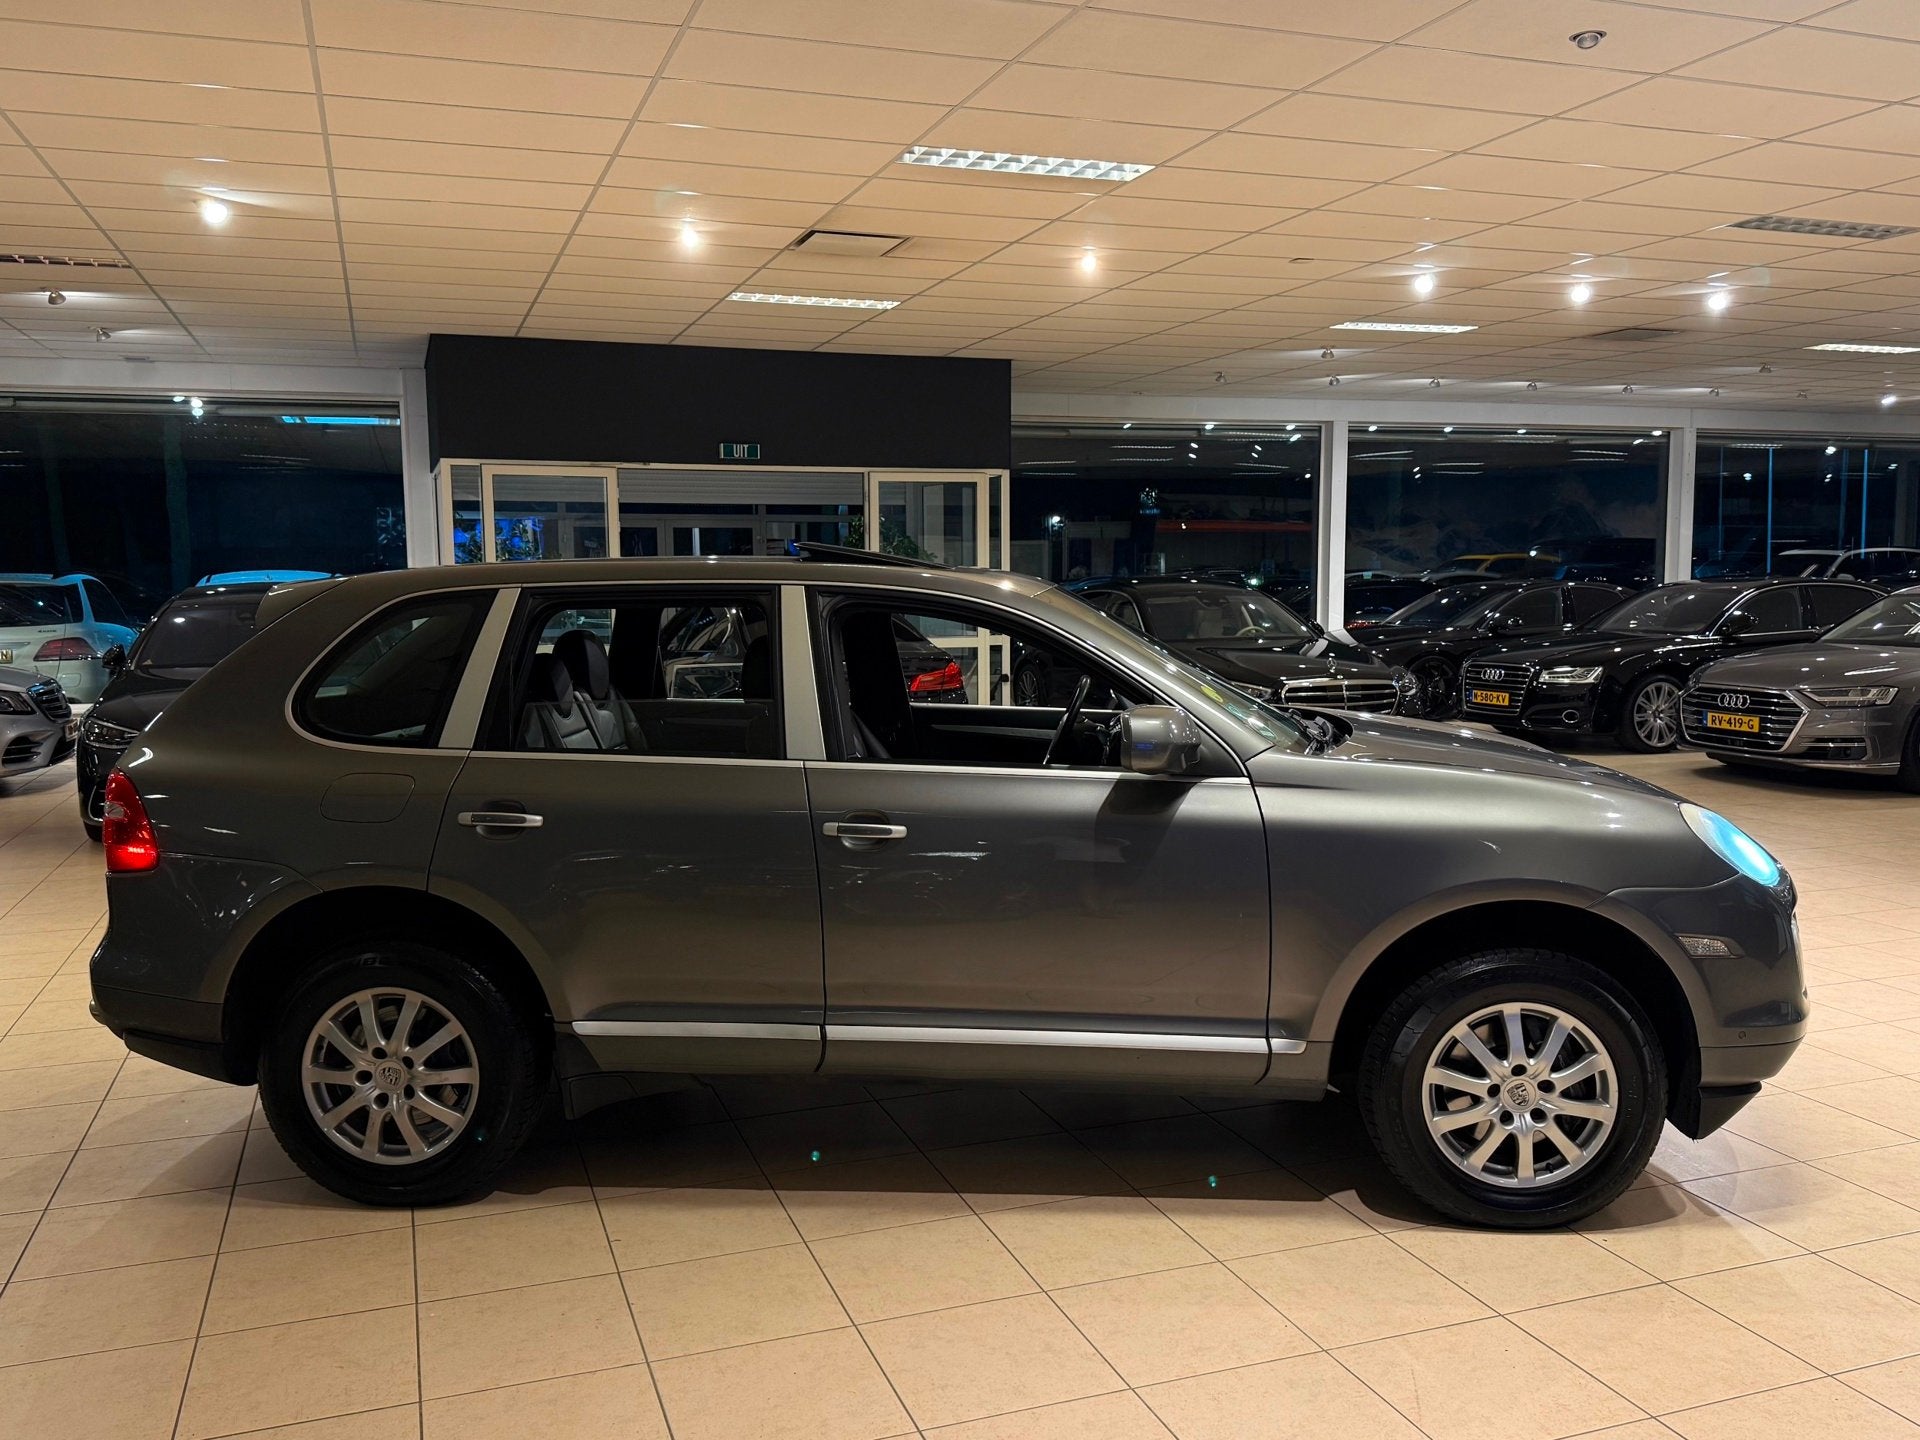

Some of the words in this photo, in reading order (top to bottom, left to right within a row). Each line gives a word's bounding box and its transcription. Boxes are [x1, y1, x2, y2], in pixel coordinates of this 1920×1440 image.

[733, 444, 748, 458] UIT
[1473, 691, 1507, 704] N-580-KV
[1711, 714, 1755, 730] RV-419-G
